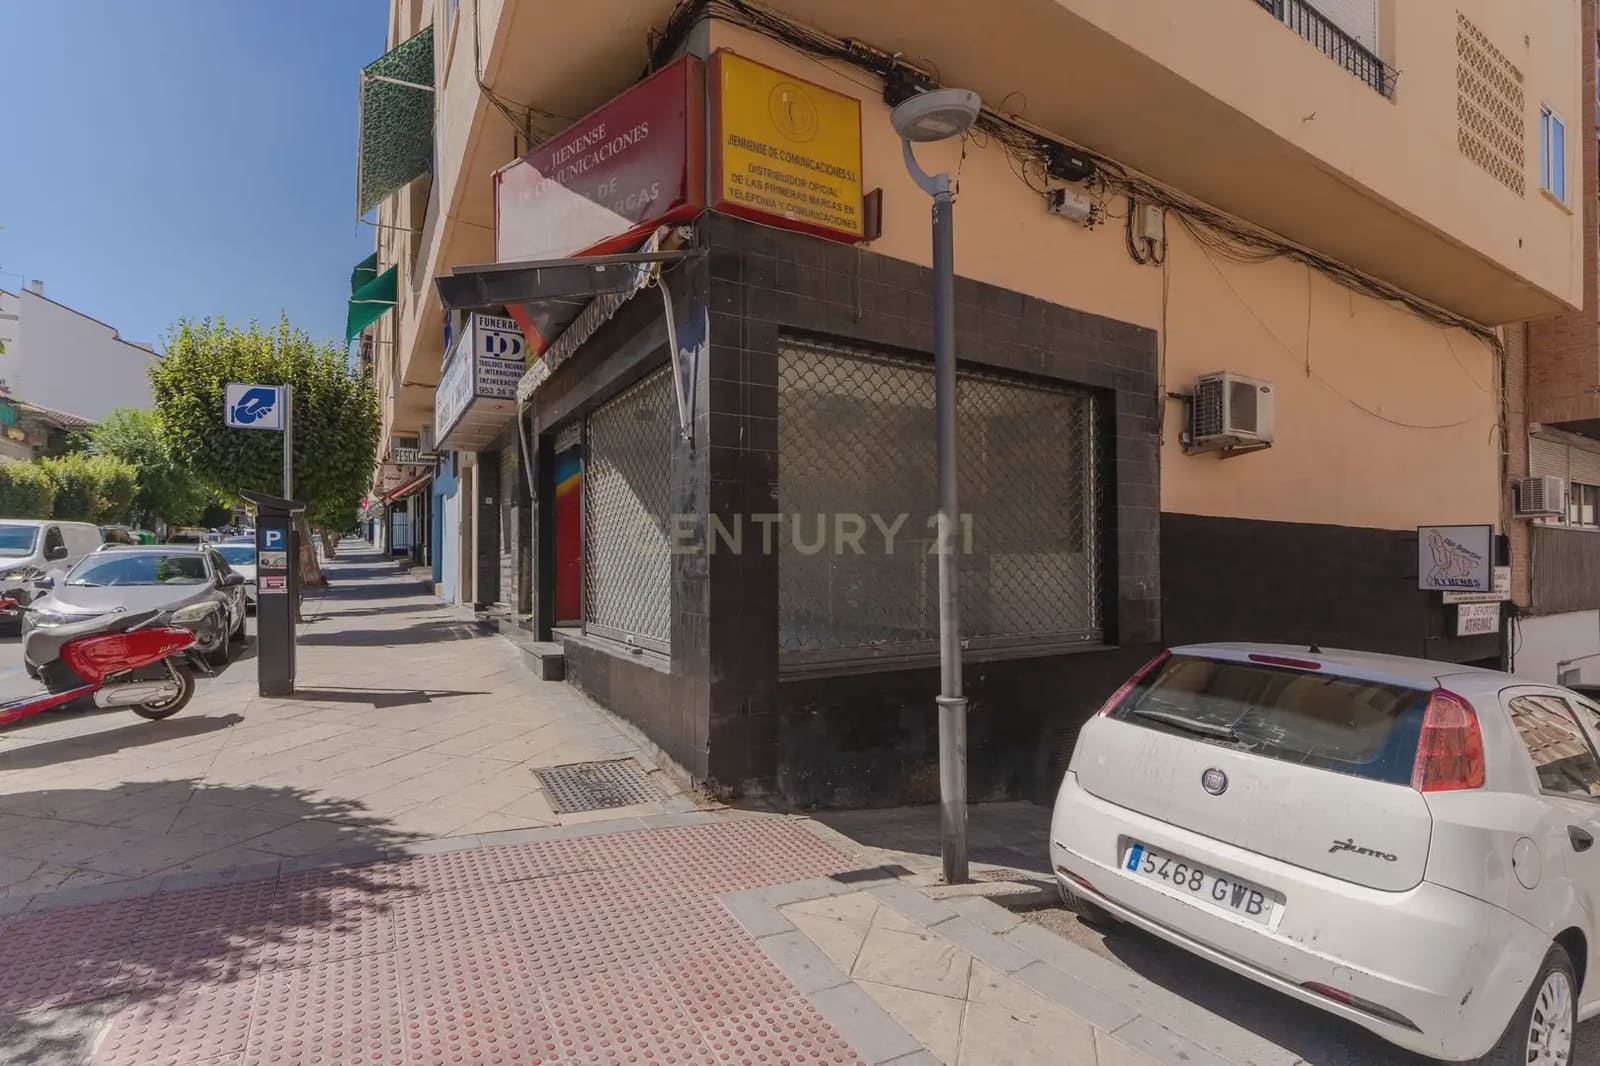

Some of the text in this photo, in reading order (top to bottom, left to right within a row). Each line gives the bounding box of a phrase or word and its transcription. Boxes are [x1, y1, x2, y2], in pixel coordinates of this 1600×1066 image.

[540, 121, 649, 190] MUNICACIONES
[768, 146, 778, 160] DE
[780, 151, 846, 180] COMUNICACIONES
[731, 173, 855, 215] DE LAS PRIMERAS MARCAS EN
[749, 163, 839, 198] DISTRIBUIDOR OFICIAL
[779, 200, 785, 211] Y
[786, 202, 857, 230] COMUNICACIONES
[479, 316, 522, 331] FUNERAR
[479, 377, 518, 387] INCINERACIO
[479, 386, 494, 395] 953
[496, 387, 506, 396] 24
[266, 530, 281, 546] P
[1143, 853, 1265, 916] 5468 GWB
